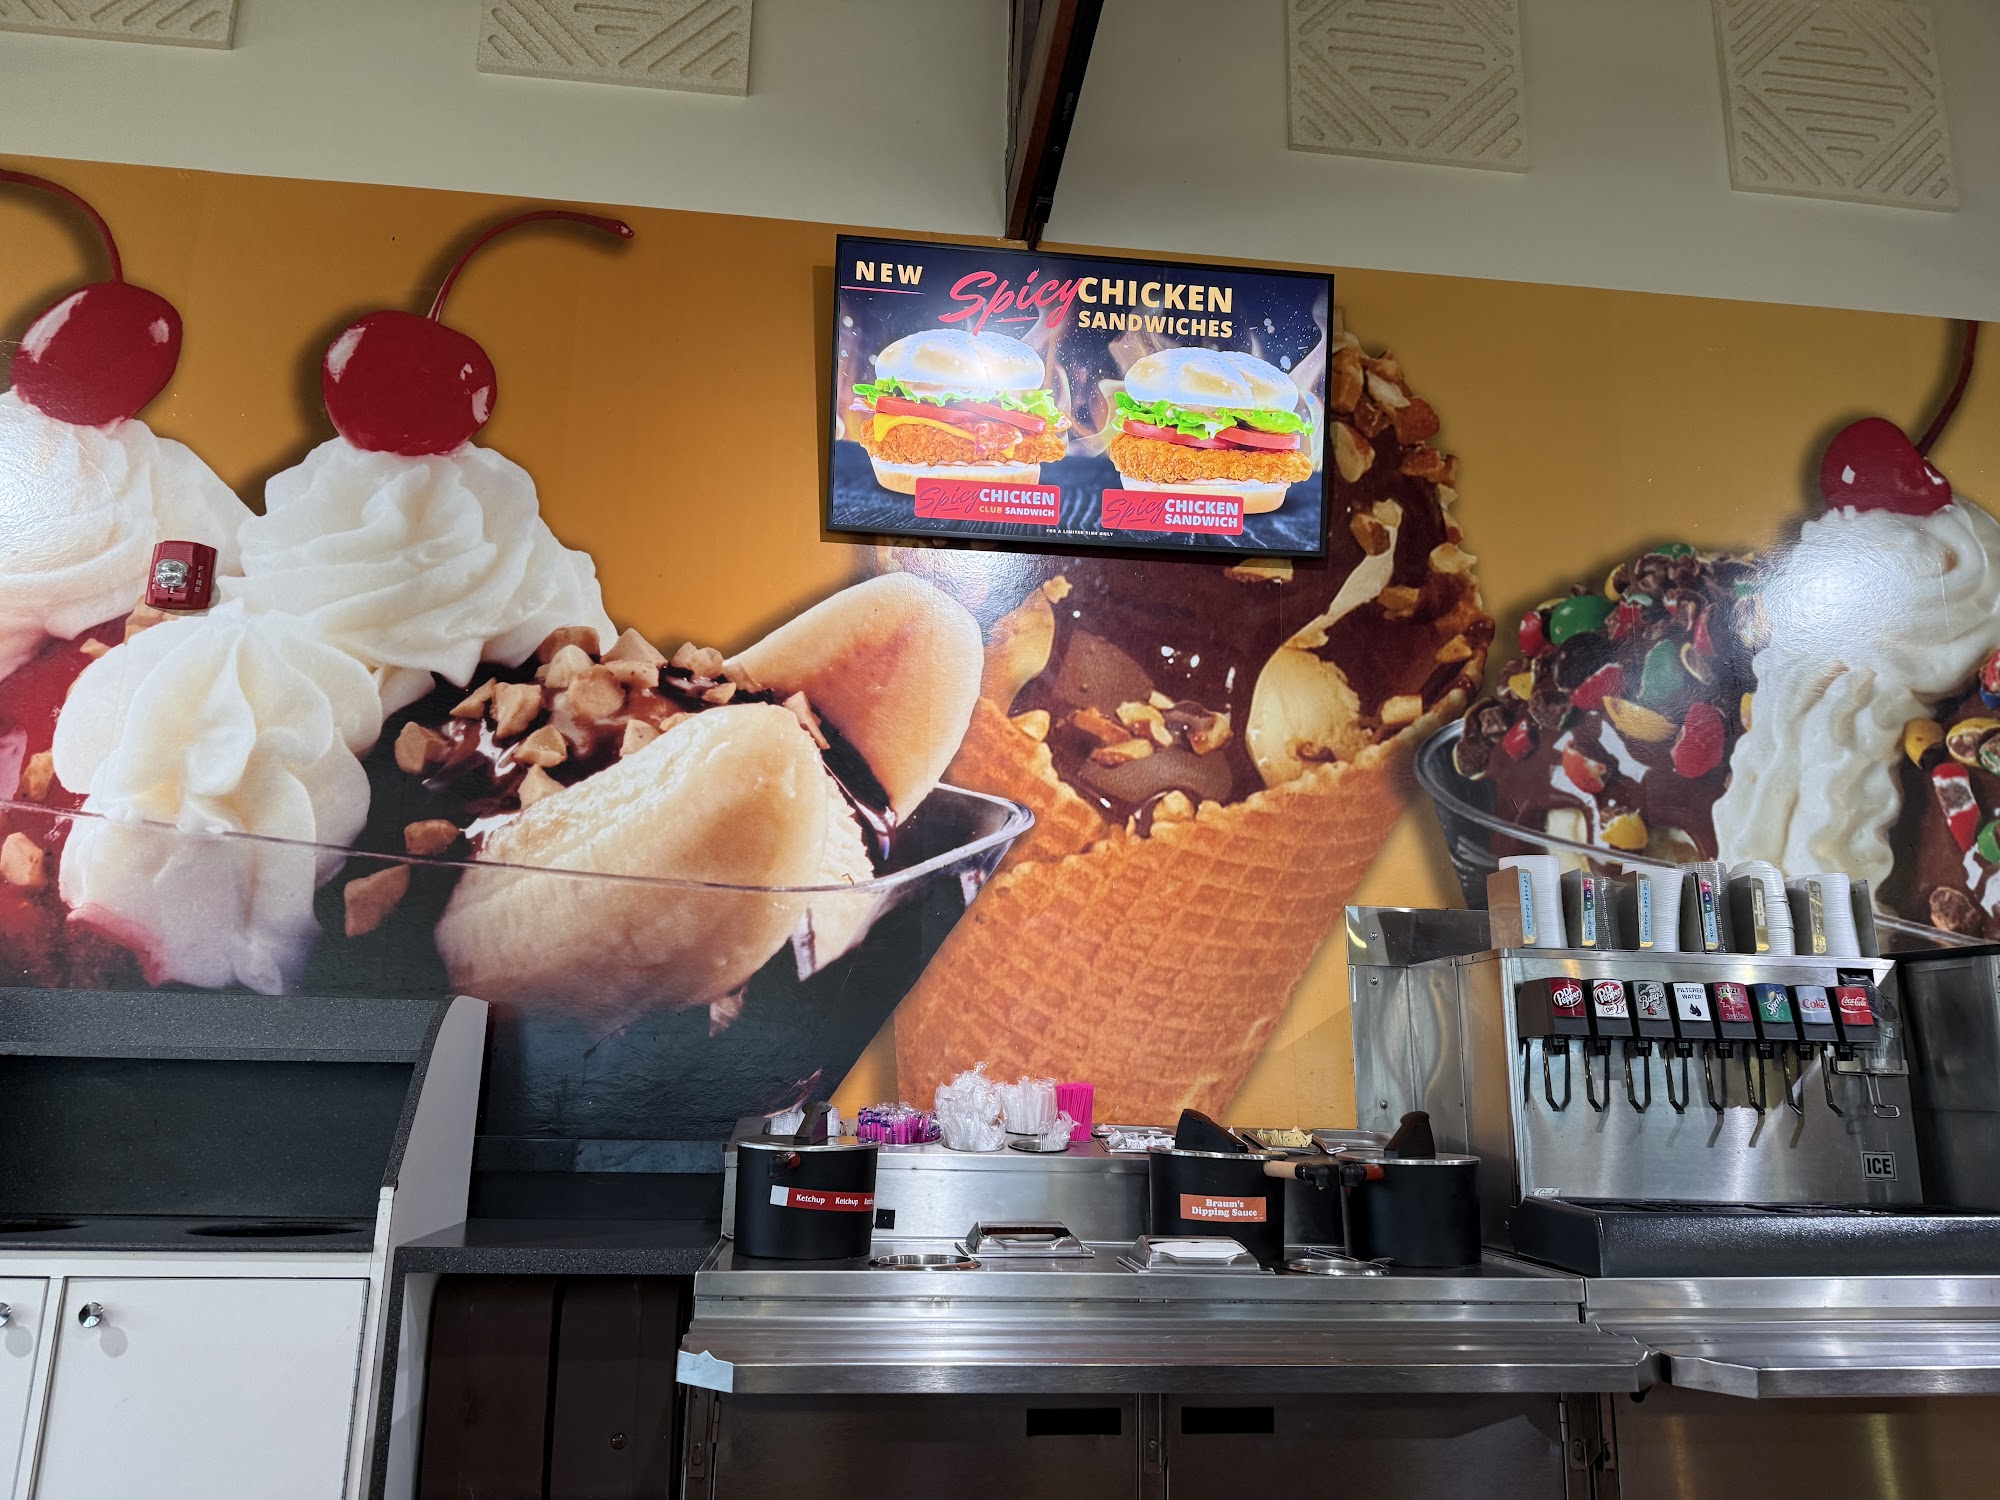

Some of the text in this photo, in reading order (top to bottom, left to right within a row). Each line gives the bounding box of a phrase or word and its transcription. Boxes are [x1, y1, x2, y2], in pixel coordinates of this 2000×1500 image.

[855, 260, 923, 285] NEW
[938, 268, 1233, 336] Spicy CHICKEN
[1077, 310, 1233, 338] SANDWICHES
[915, 487, 1055, 517] Spicy CHICKEN
[979, 505, 1055, 517] CLUB SANDWICH
[1103, 498, 1239, 529] Spicy CHICKEN
[1164, 513, 1238, 528] SANDWICH
[194, 565, 204, 593] FIRE
[1556, 986, 1580, 1006] Dr Pepper
[1597, 985, 1621, 1004] Dr Pepper
[1766, 992, 1784, 1015] Sprite
[1802, 998, 1827, 1009] Coke
[1866, 1157, 1892, 1175] ICE
[796, 1193, 826, 1206] Ketchup
[835, 1196, 859, 1207] Ketchup
[1205, 1198, 1245, 1208] Braum's
[1191, 1206, 1258, 1218] Dipping Sauce
